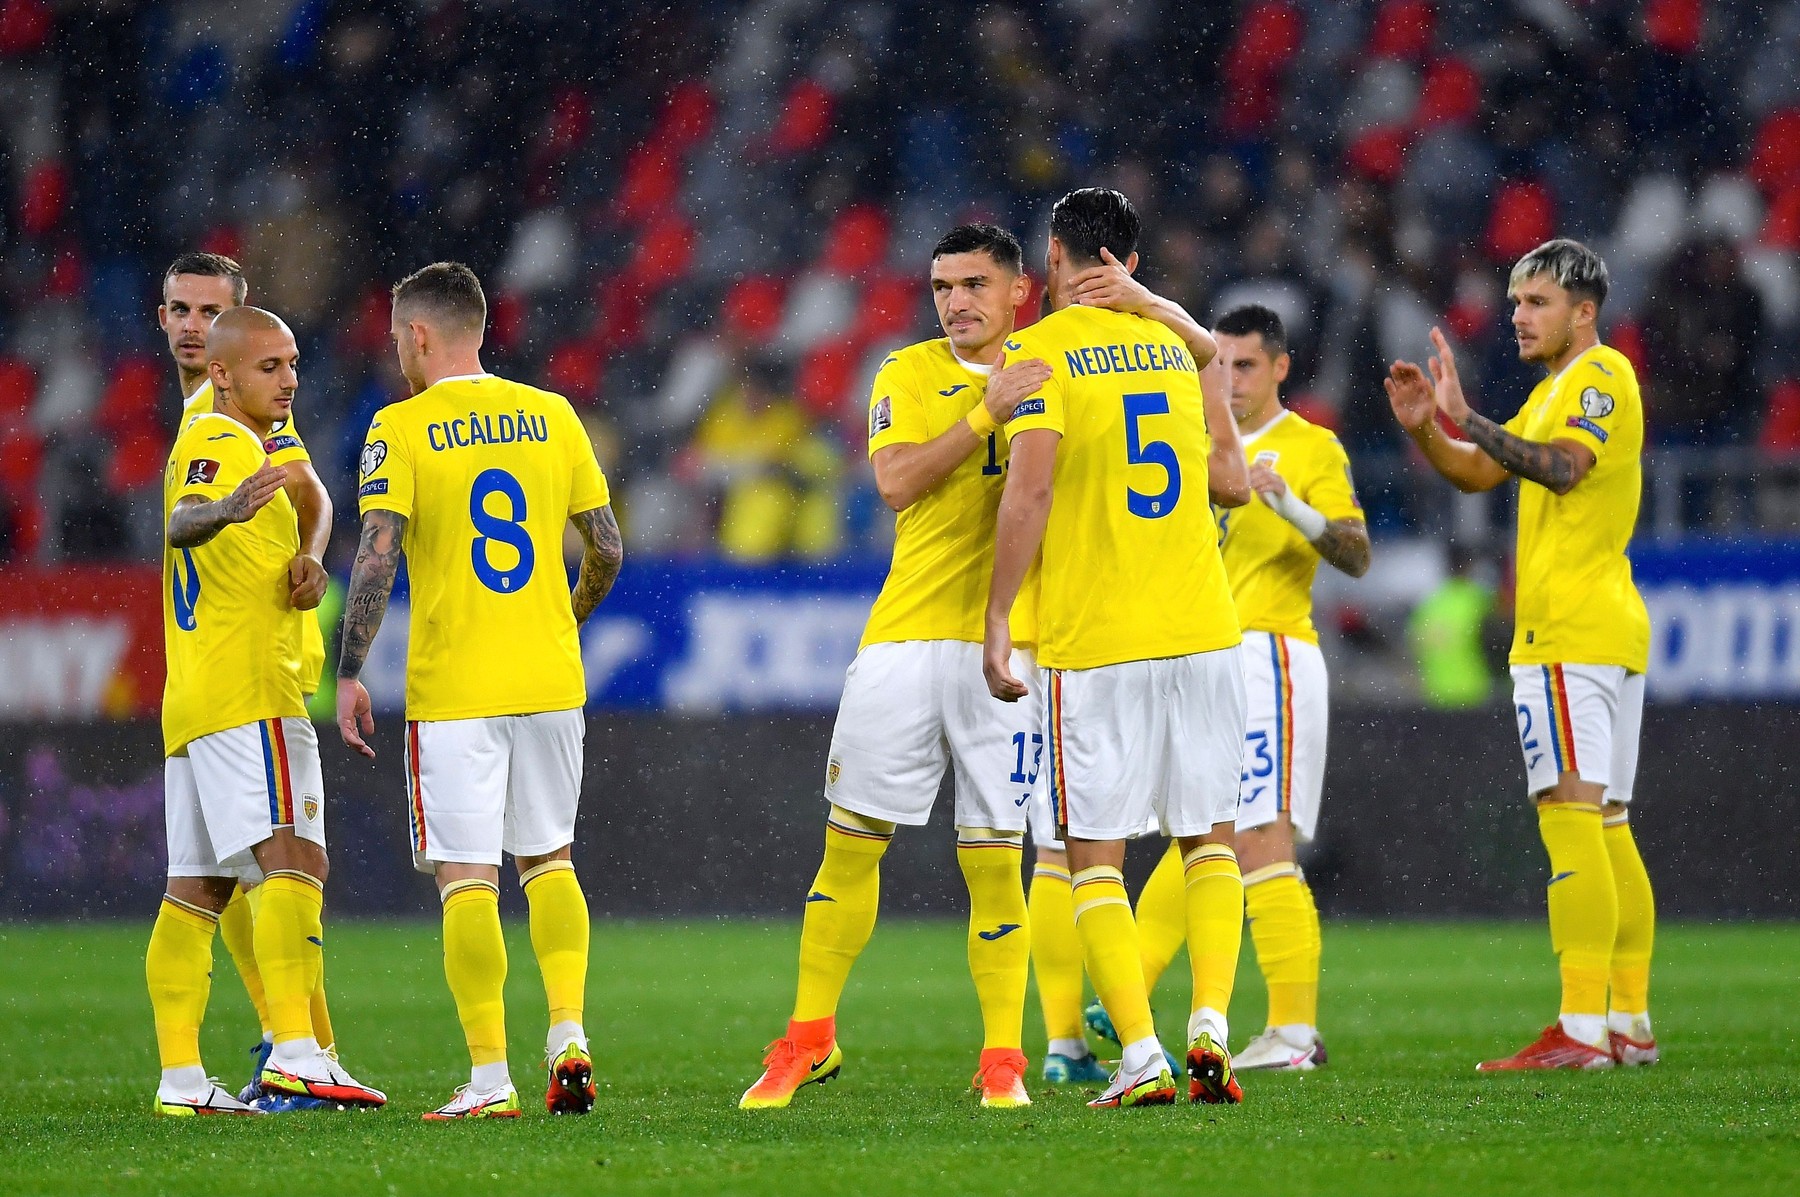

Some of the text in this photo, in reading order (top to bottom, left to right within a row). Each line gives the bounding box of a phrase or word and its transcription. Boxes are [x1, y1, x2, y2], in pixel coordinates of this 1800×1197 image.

[427, 409, 548, 452] CICÂLDĂU
[982, 431, 1009, 475] 1
[1123, 391, 1182, 519] 5
[469, 467, 535, 594] 8
[1010, 732, 1043, 784] 13
[1241, 730, 1273, 777] 3
